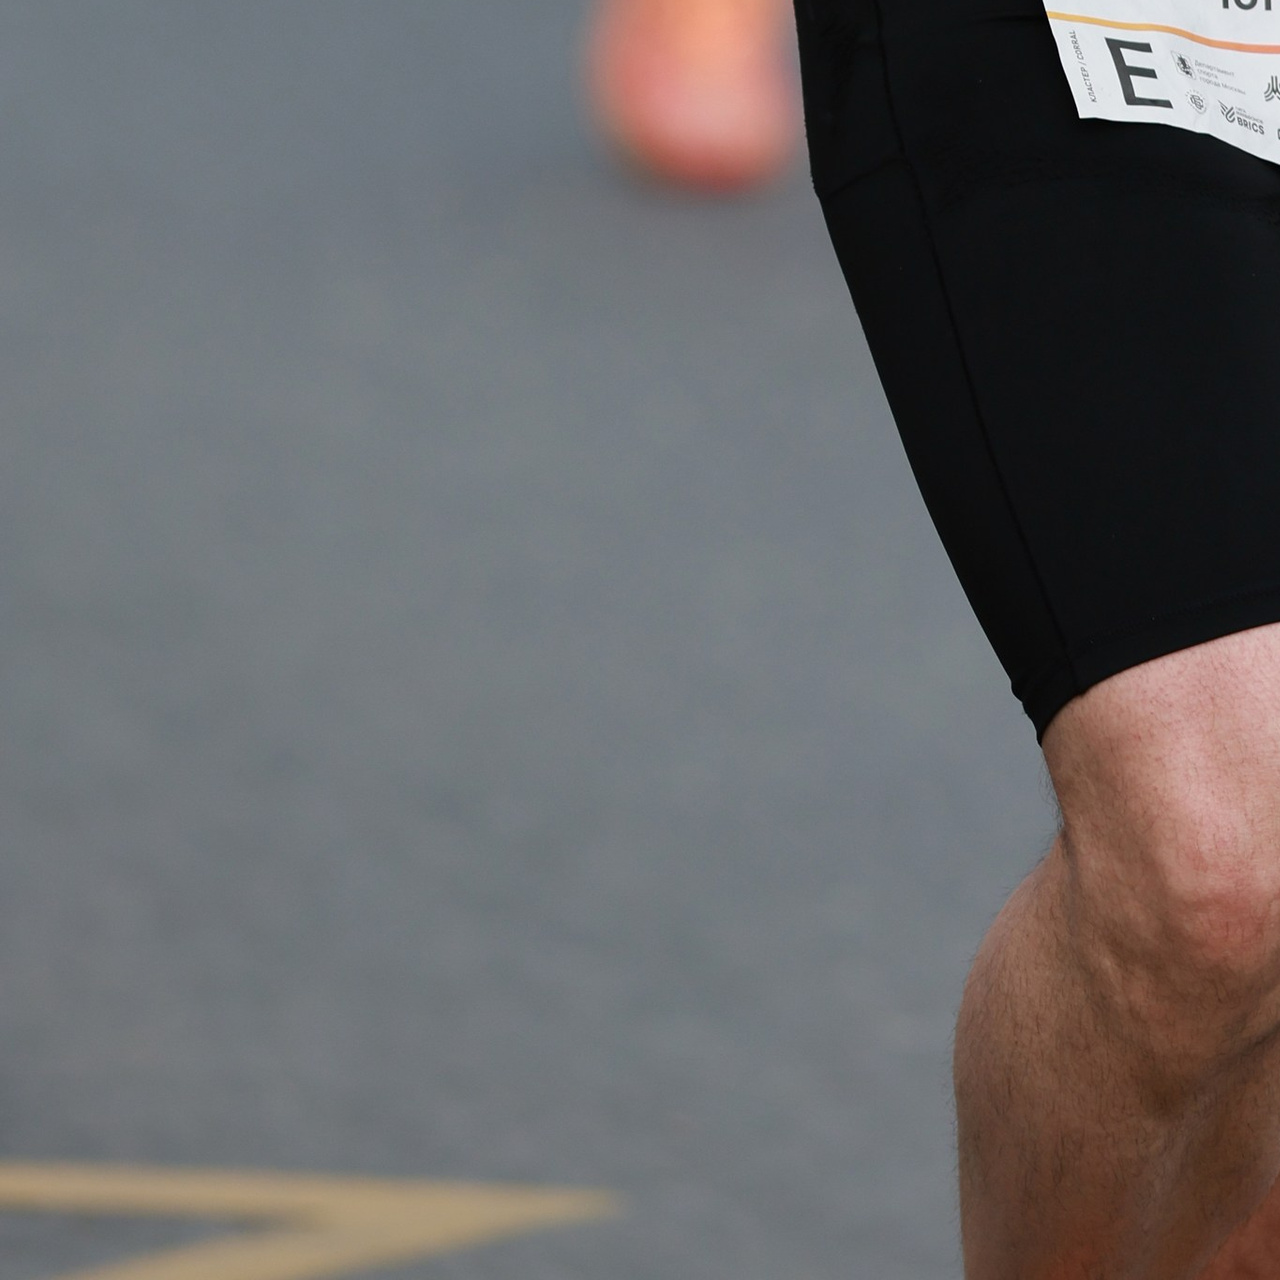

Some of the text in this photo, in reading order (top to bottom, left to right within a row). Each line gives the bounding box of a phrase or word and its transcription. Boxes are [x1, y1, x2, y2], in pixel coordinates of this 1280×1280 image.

[1071, 30, 1084, 60] CORRAL
[1079, 67, 1097, 103] КЛАСТЕР
[1104, 37, 1174, 109] E
[1237, 116, 1265, 136] BRICS
